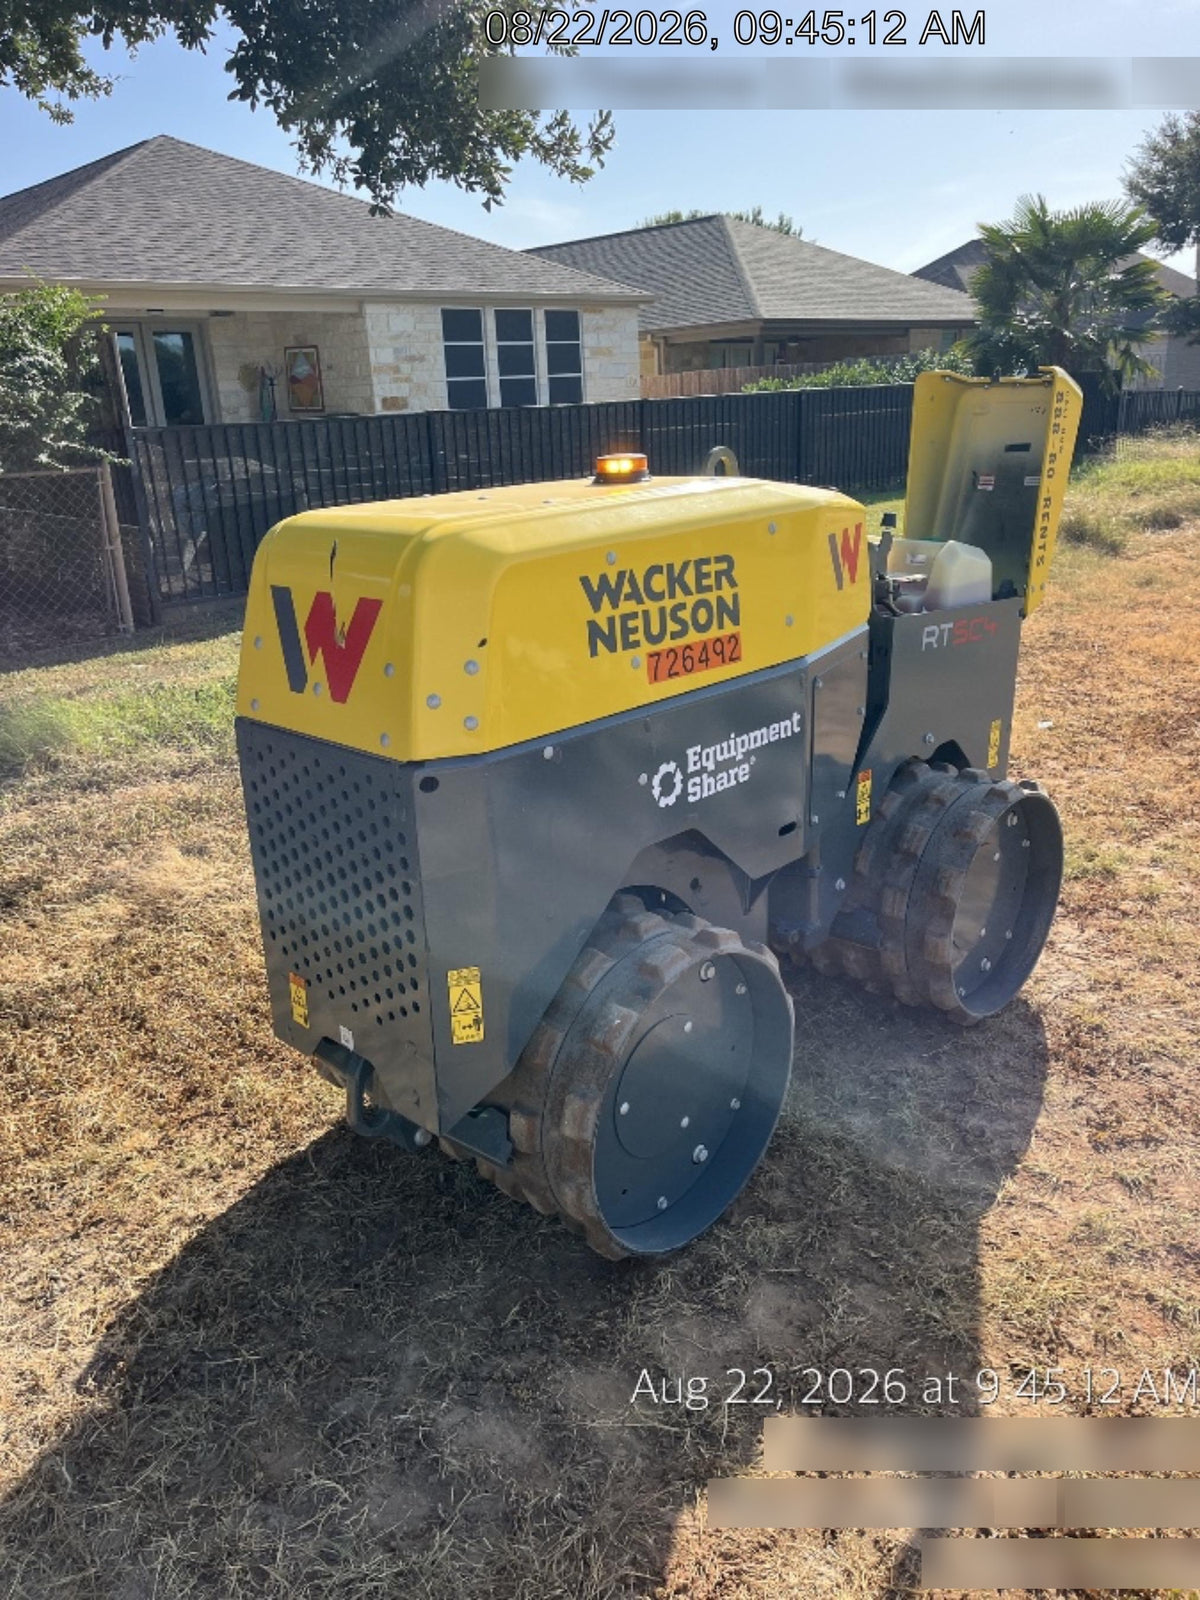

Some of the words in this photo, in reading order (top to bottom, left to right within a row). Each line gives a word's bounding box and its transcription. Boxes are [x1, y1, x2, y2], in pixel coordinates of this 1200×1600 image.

[579, 554, 738, 613] WACKER
[586, 593, 740, 658] NEUSON
[649, 633, 740, 682] 726492
[686, 711, 801, 774] Equipment
